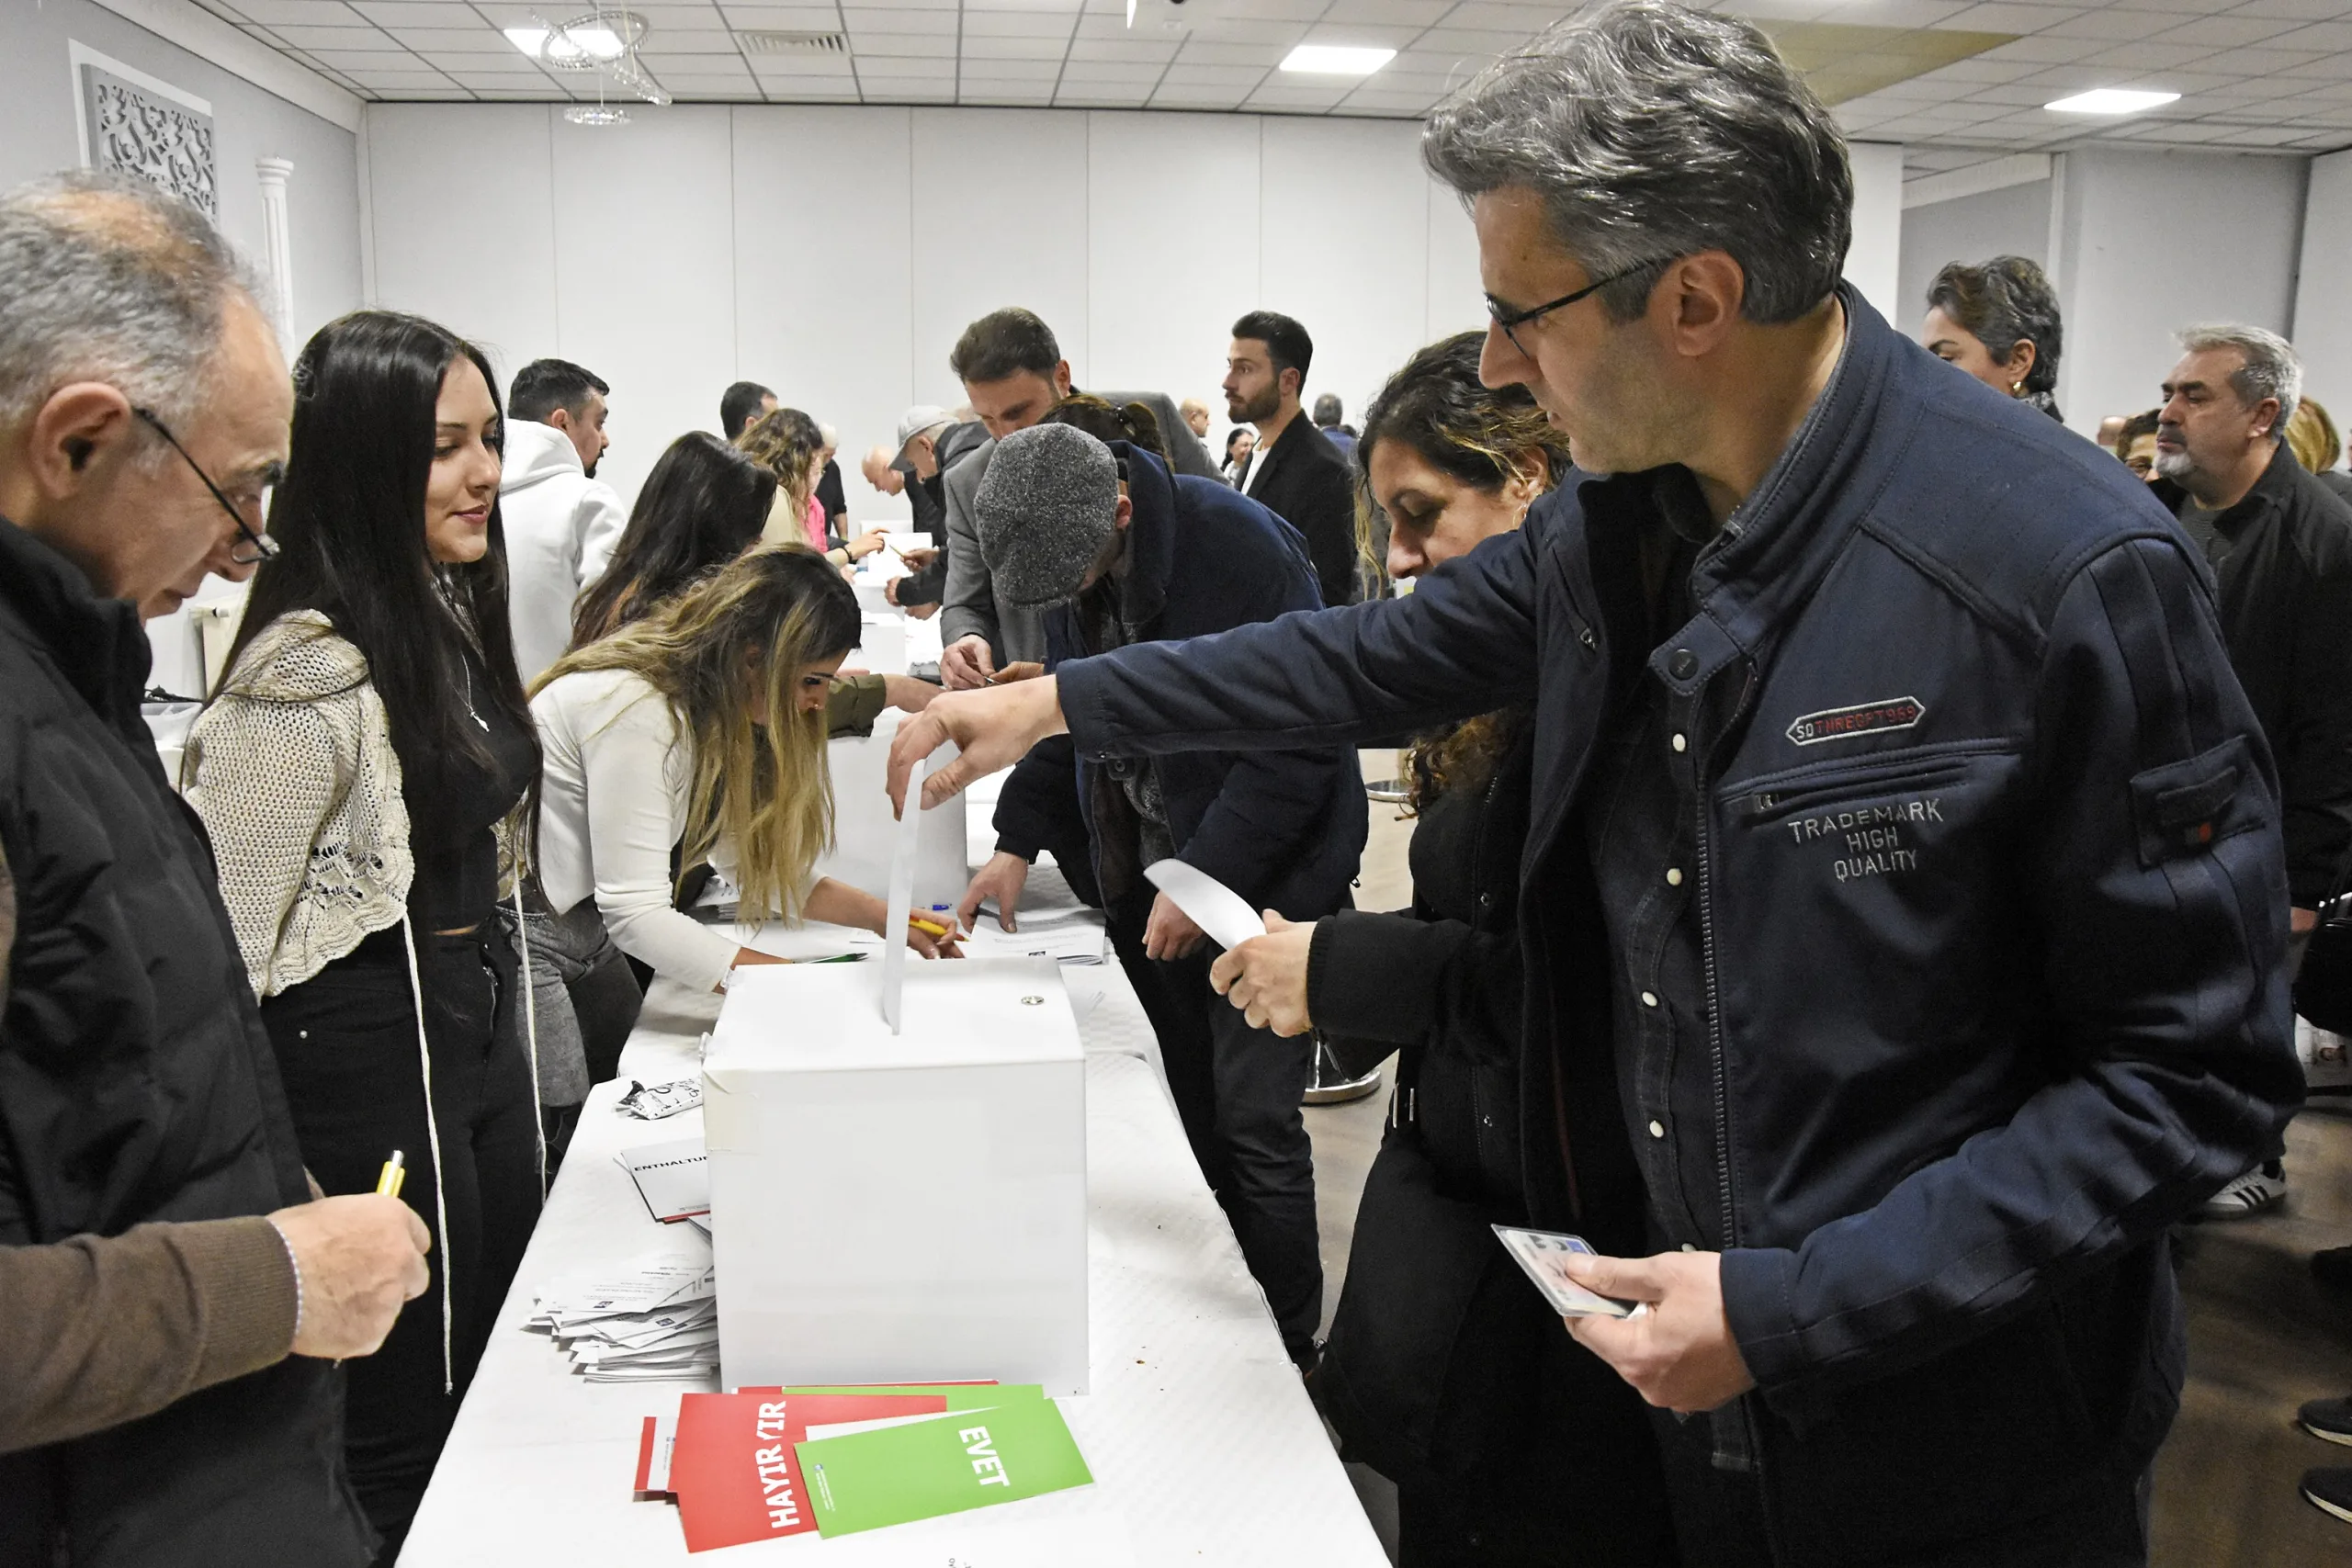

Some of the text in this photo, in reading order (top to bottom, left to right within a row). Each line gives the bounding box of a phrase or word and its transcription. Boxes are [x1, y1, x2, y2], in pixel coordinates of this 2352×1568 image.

[1787, 797, 1944, 844] TRADEMARK
[1845, 826, 1899, 854] HIGH
[1833, 849, 1917, 883] QUALITY
[958, 1426, 1011, 1487] EVET
[754, 1443, 800, 1529] HAYIR
